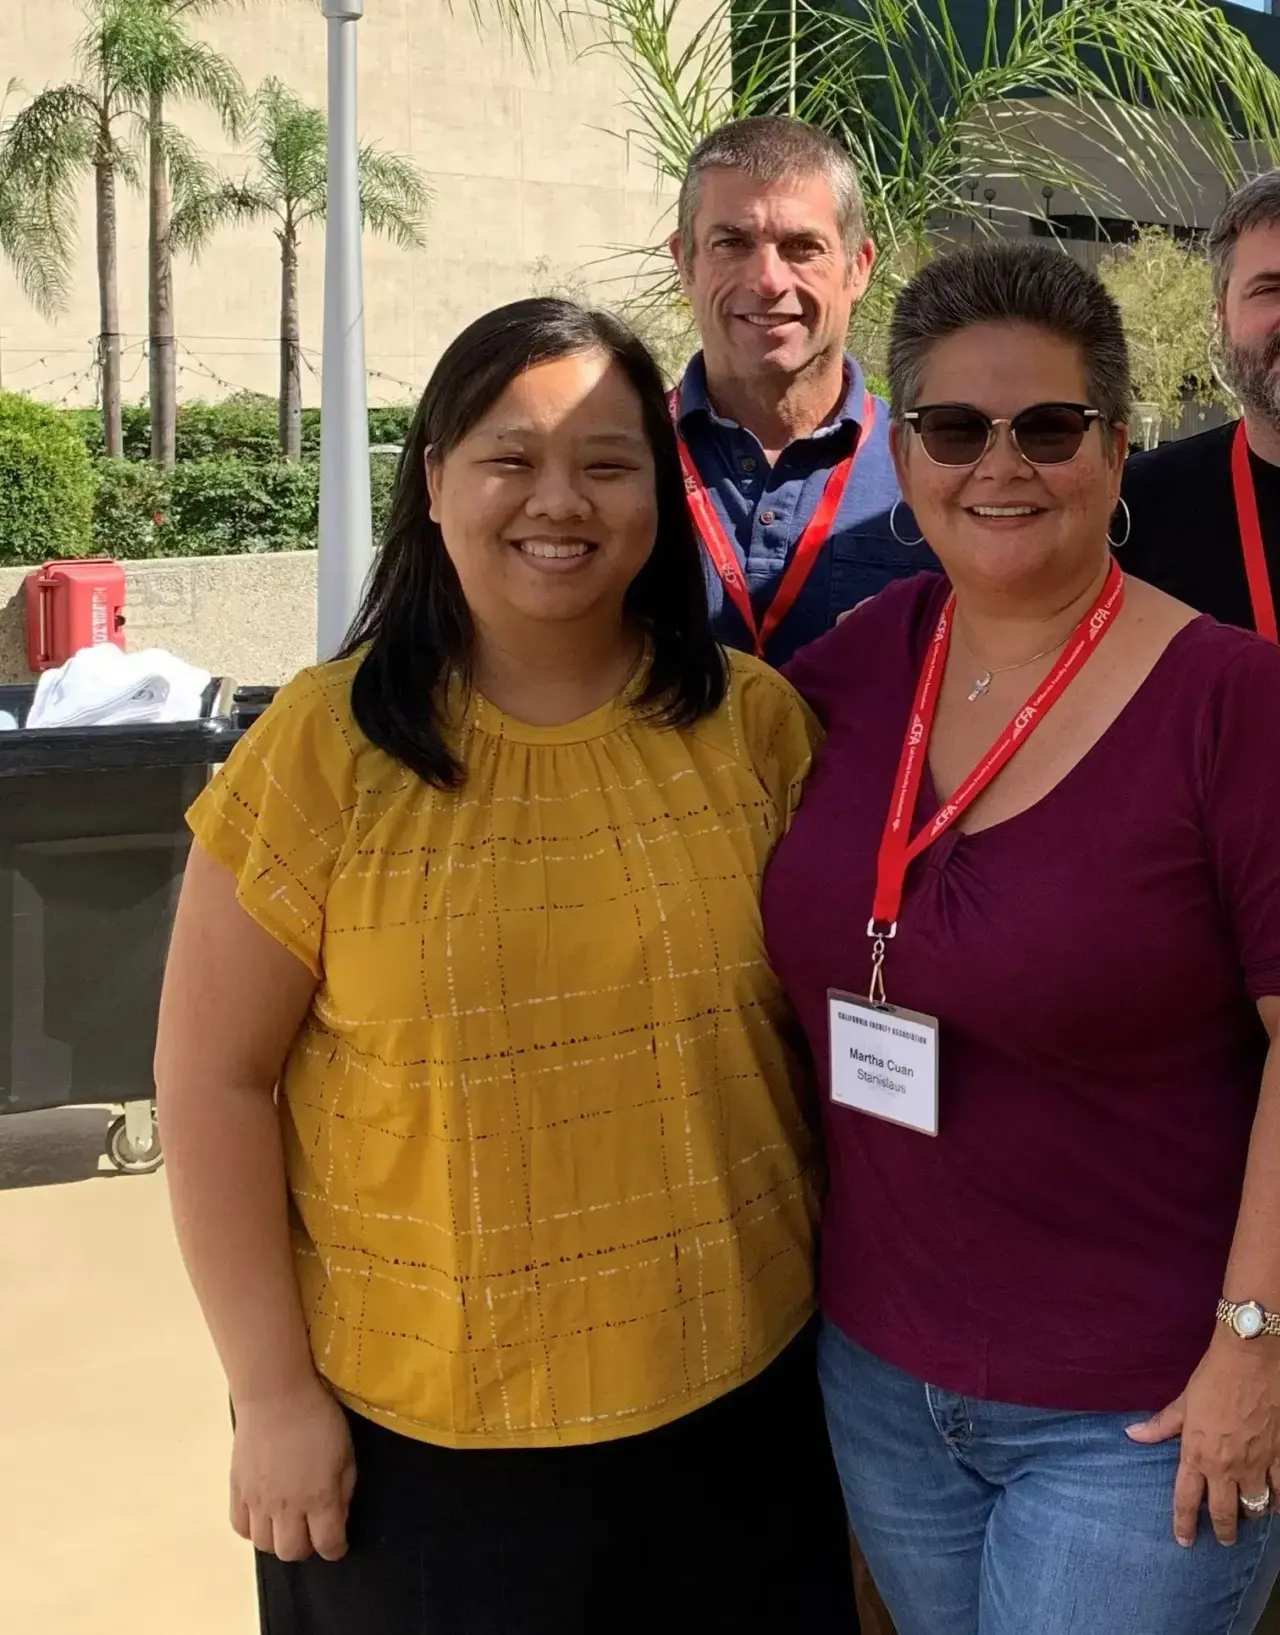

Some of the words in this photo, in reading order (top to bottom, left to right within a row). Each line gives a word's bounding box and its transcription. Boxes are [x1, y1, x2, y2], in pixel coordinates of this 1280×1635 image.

[1090, 608, 1111, 630] CFA
[934, 620, 947, 642] CFA
[1014, 705, 1037, 729] CFA
[908, 723, 924, 745] CFA
[935, 805, 958, 826] CFA
[849, 1047, 884, 1068] Martha
[887, 1059, 914, 1078] Cuan
[857, 1068, 906, 1094] Stanislaus
